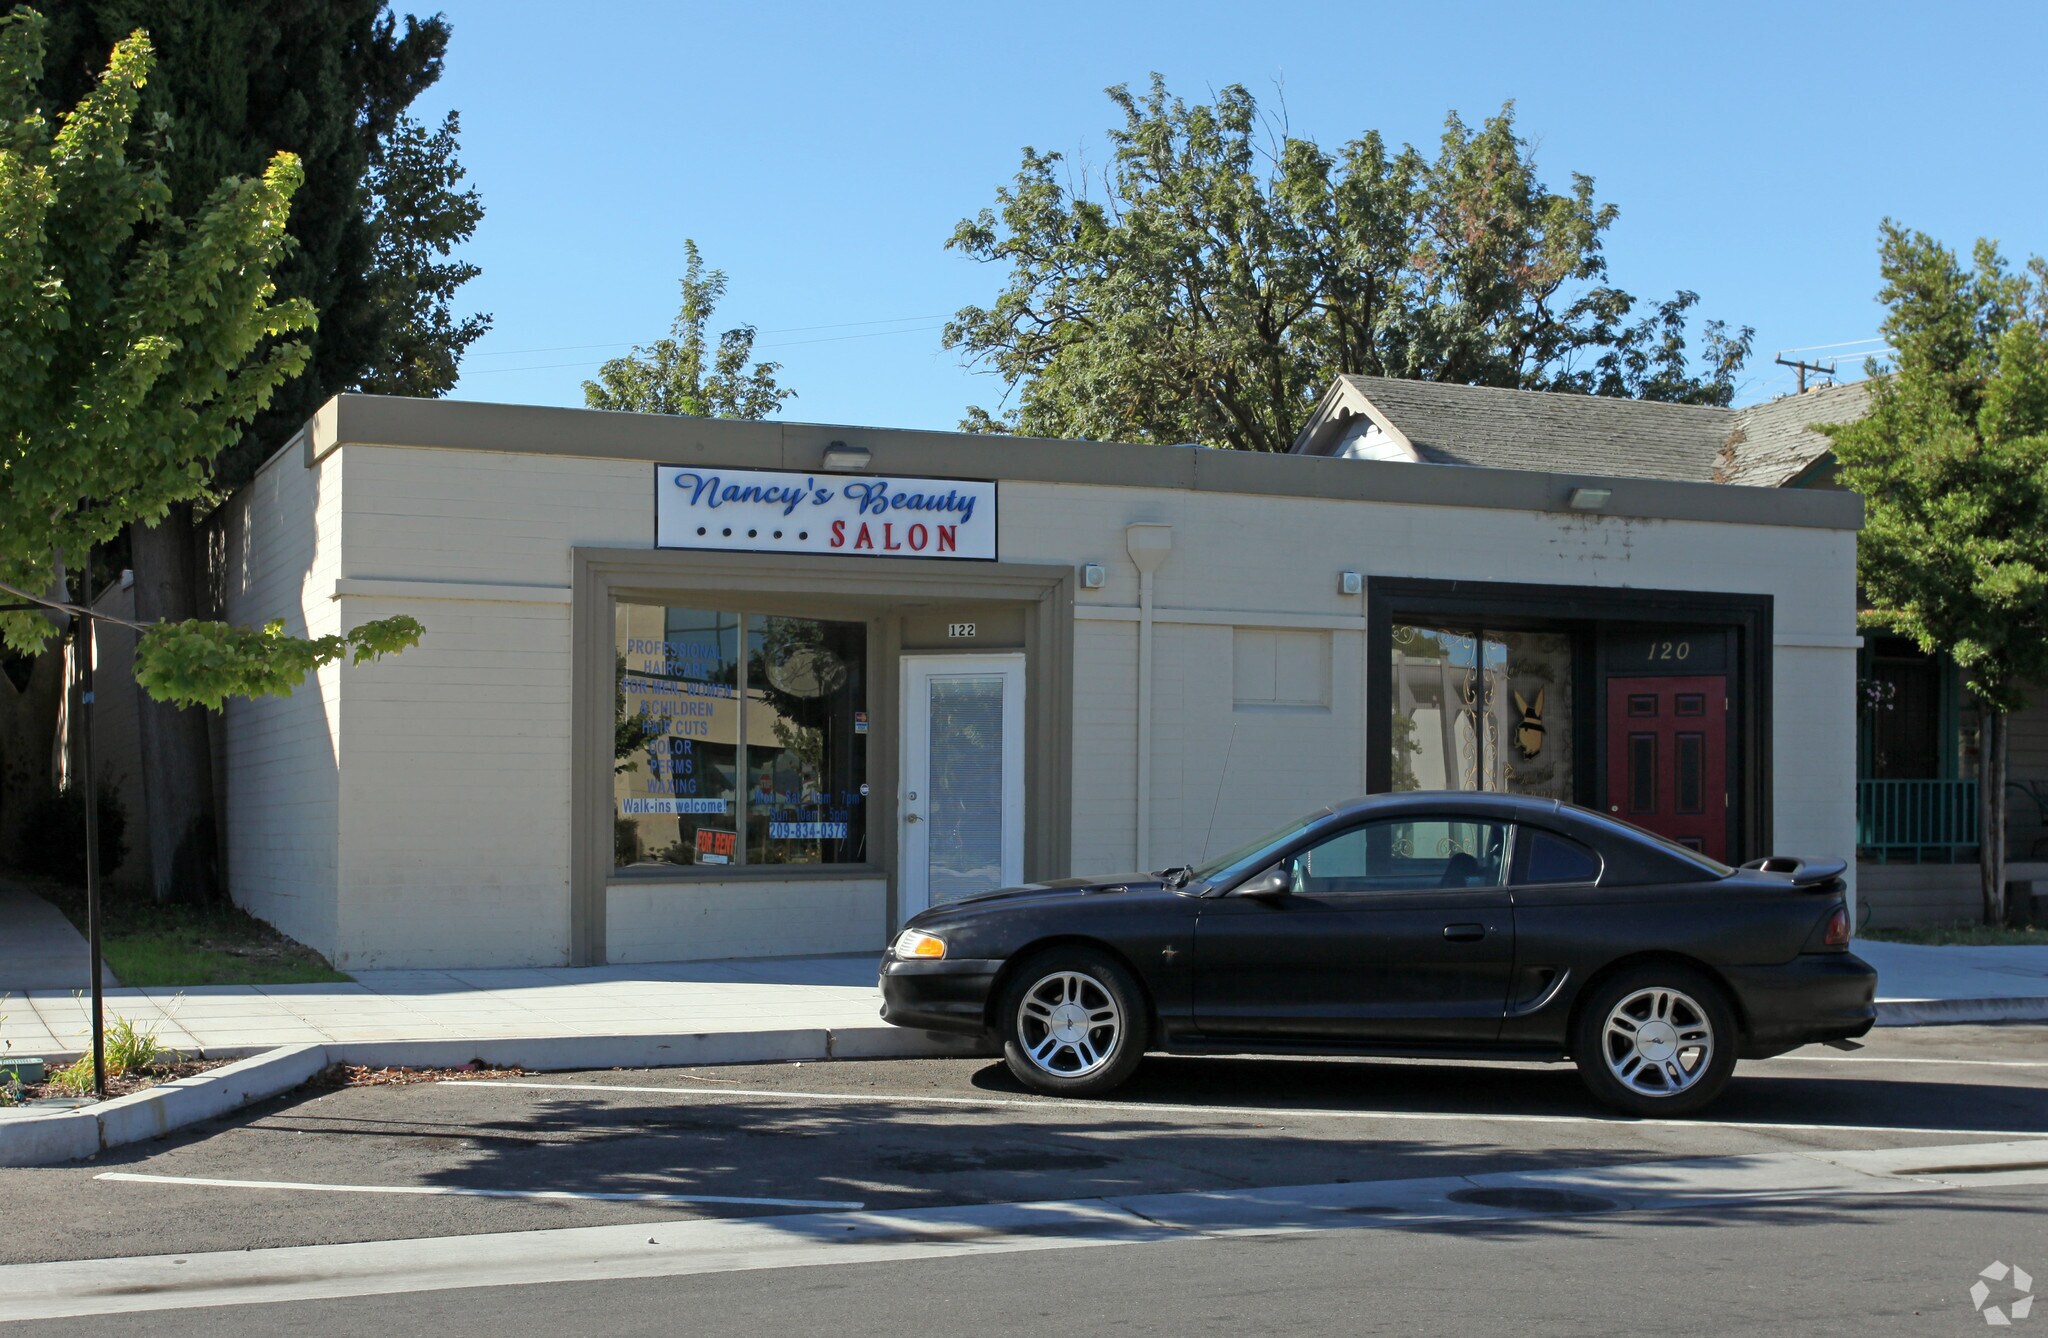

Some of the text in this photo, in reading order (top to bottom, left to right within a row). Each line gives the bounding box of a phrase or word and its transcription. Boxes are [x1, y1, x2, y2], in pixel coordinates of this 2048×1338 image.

[674, 473, 976, 524] Nancy's Beauty
[830, 520, 957, 552] SALON
[951, 624, 974, 636] 122
[627, 639, 722, 660] PROFESSIONAL
[1647, 641, 1690, 661] 120
[644, 660, 708, 678] HAIRCARE
[623, 677, 732, 699] FOR MEN, WOMEN
[640, 699, 714, 717] & CHILDREN
[642, 719, 708, 735] HAIR CUTS
[650, 739, 692, 754] COLOR
[650, 760, 692, 774] PERMS
[648, 779, 696, 794] WAXING
[623, 798, 727, 813] Walk-ins welcome!
[842, 791, 860, 805] 7pm
[770, 807, 792, 821] Sun:
[795, 807, 819, 821] 10am
[829, 809, 848, 822] 5pm
[769, 822, 848, 838] 209-834-0378
[698, 831, 736, 856] FOR RENT
